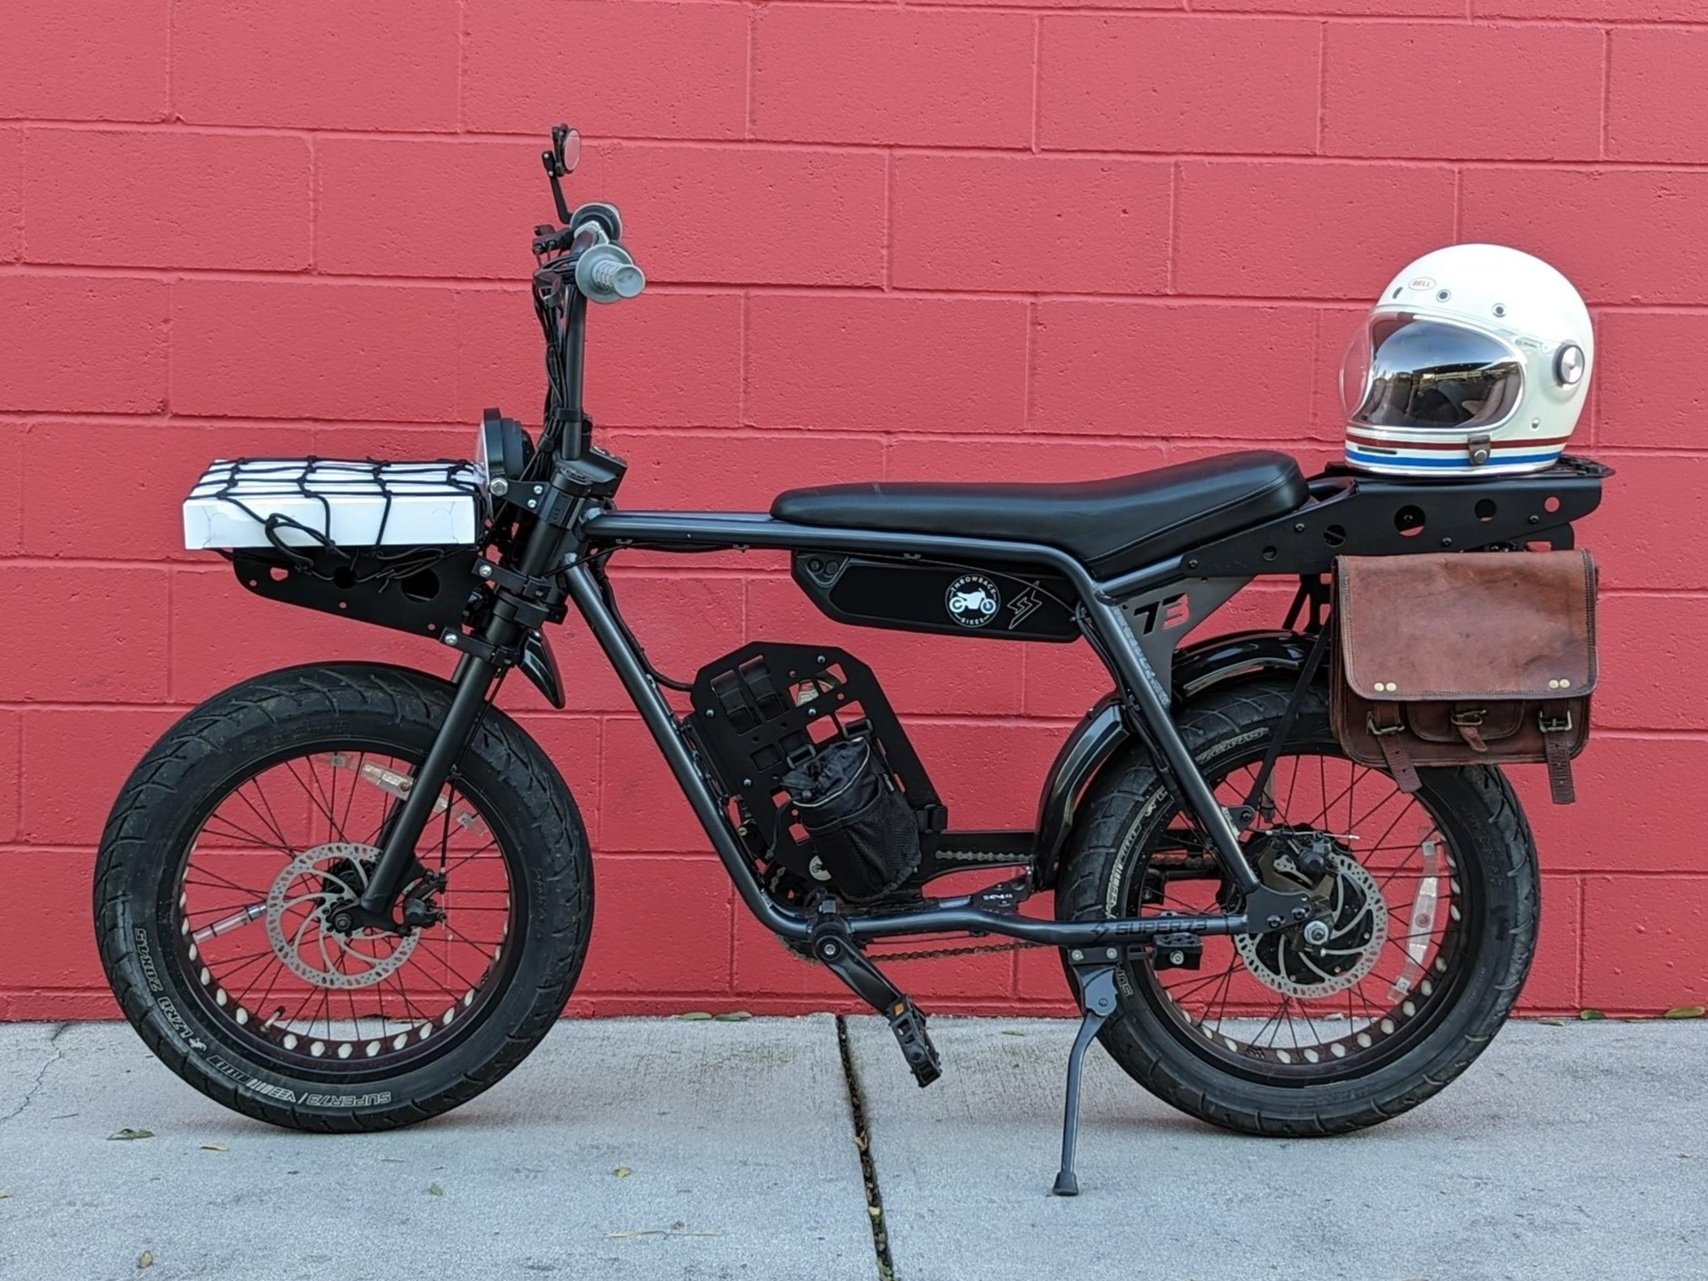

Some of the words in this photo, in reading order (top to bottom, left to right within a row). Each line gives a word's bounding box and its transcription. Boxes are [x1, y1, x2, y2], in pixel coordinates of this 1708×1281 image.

[950, 576, 997, 594] THROWBACK
[1133, 592, 1190, 636] 73
[1115, 919, 1208, 936] SUPER73
[306, 1091, 392, 1108] SUPER73
